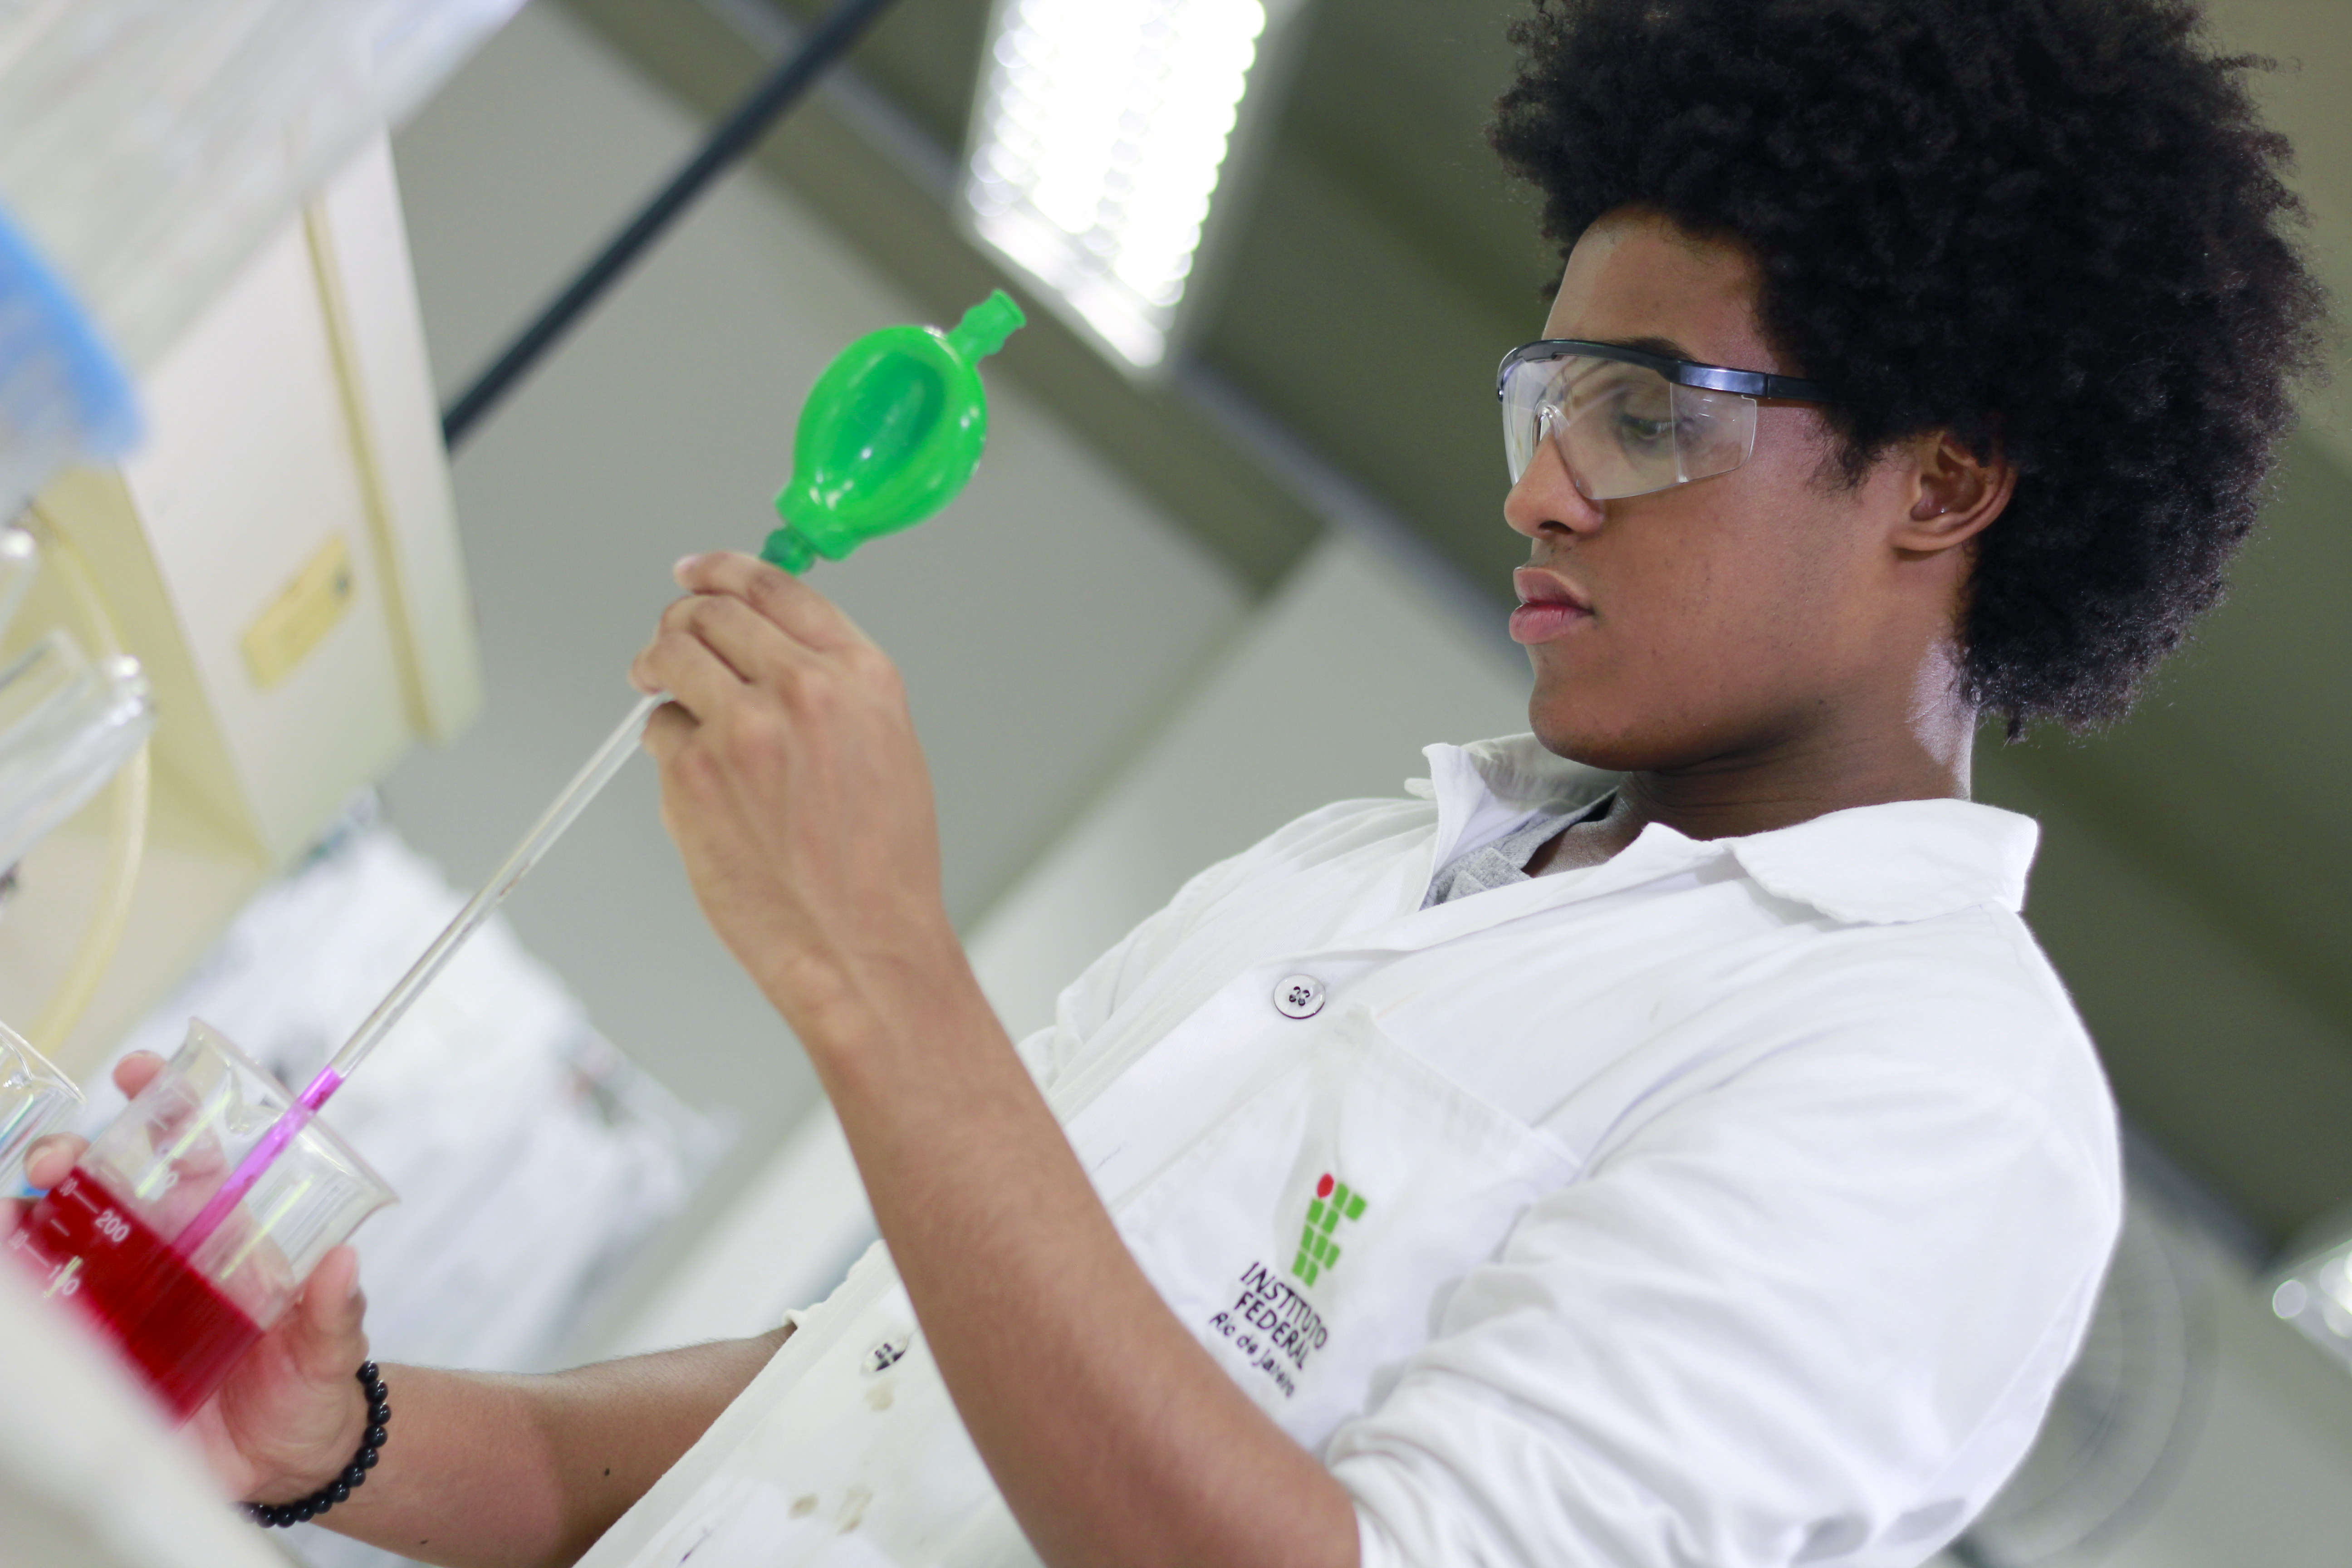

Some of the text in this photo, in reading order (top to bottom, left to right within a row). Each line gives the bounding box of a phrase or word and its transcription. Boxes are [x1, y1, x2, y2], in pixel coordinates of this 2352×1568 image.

[94, 1209, 130, 1242] 200
[49, 1264, 79, 1295] 10
[1240, 1262, 1328, 1349] INSTITUTO
[1209, 1312, 1235, 1336] Rio
[1237, 1333, 1258, 1354] de
[1234, 1291, 1309, 1370] FEDERAL
